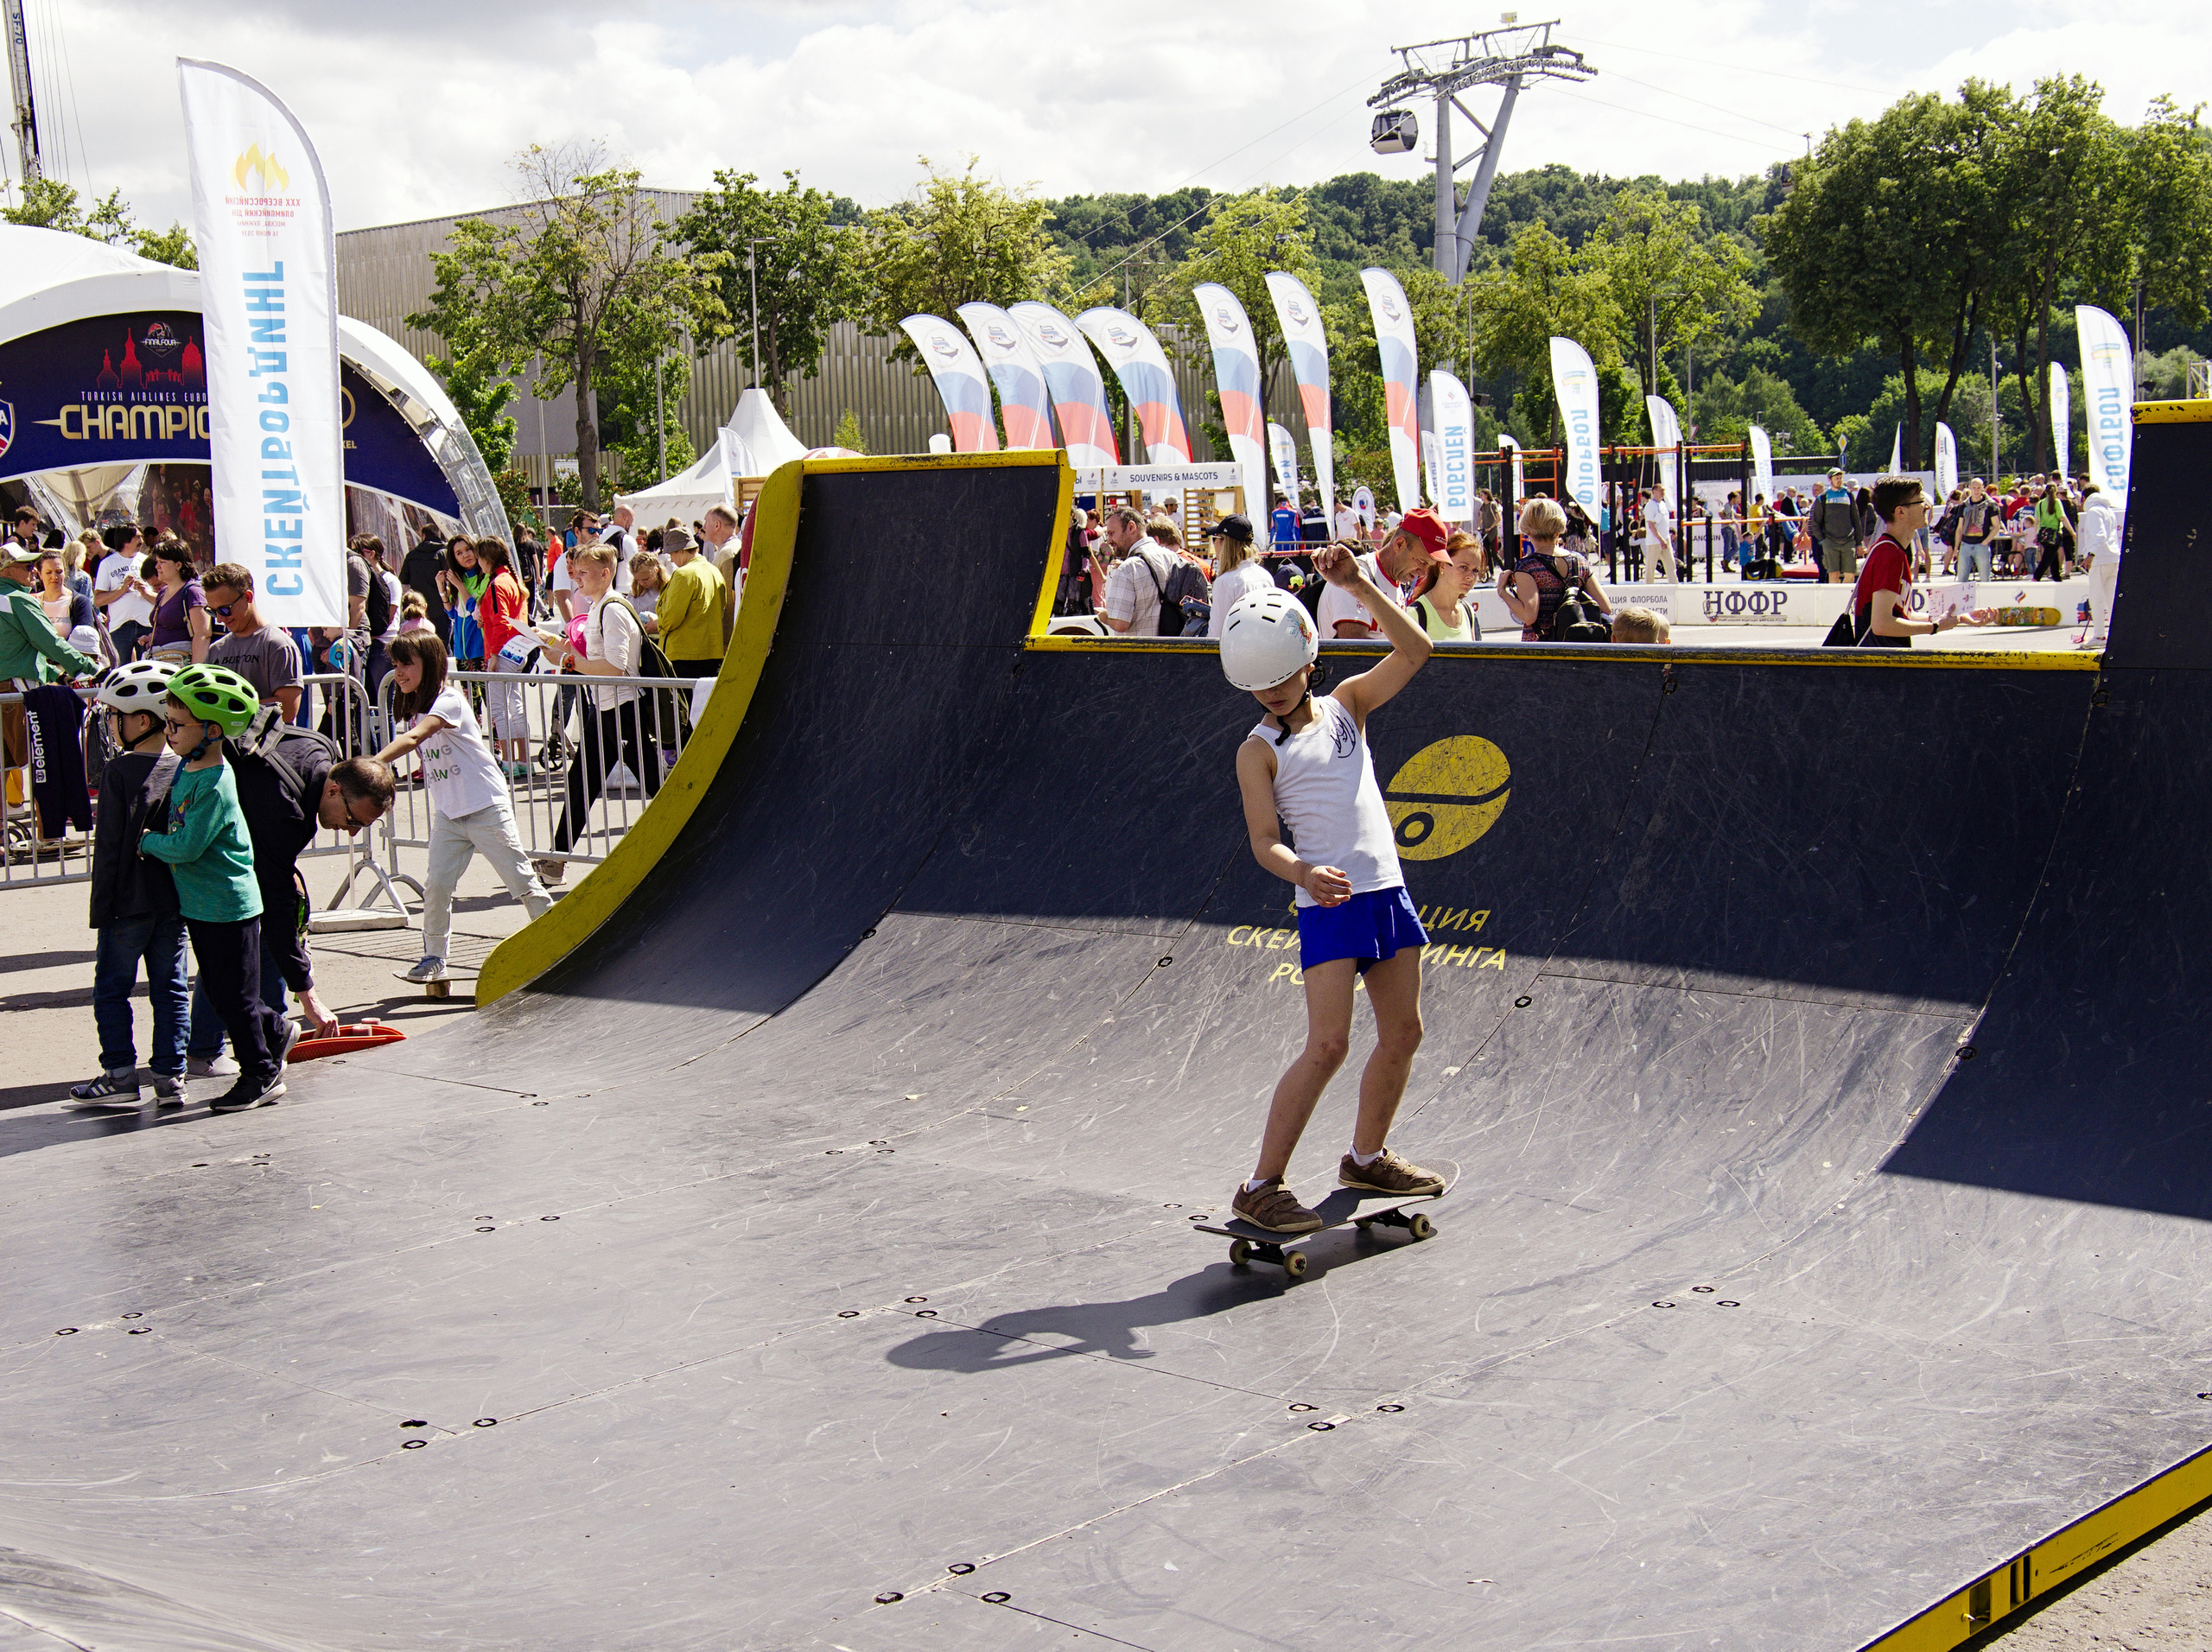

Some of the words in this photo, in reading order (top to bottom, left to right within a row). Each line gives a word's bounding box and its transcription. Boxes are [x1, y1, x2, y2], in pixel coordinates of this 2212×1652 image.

[12, 12, 23, 45] SF-70
[80, 391, 124, 402] TURKISH
[130, 391, 176, 403] AIRLINES
[1129, 473, 1173, 483] SOUVENIRS
[1174, 473, 1180, 481] &
[1181, 472, 1218, 481] MASCOTS
[110, 565, 130, 578] GRAND
[1630, 595, 1669, 604] ФЛОРБОЛА
[1703, 590, 1788, 615] НФФР
[27, 710, 46, 769] element
